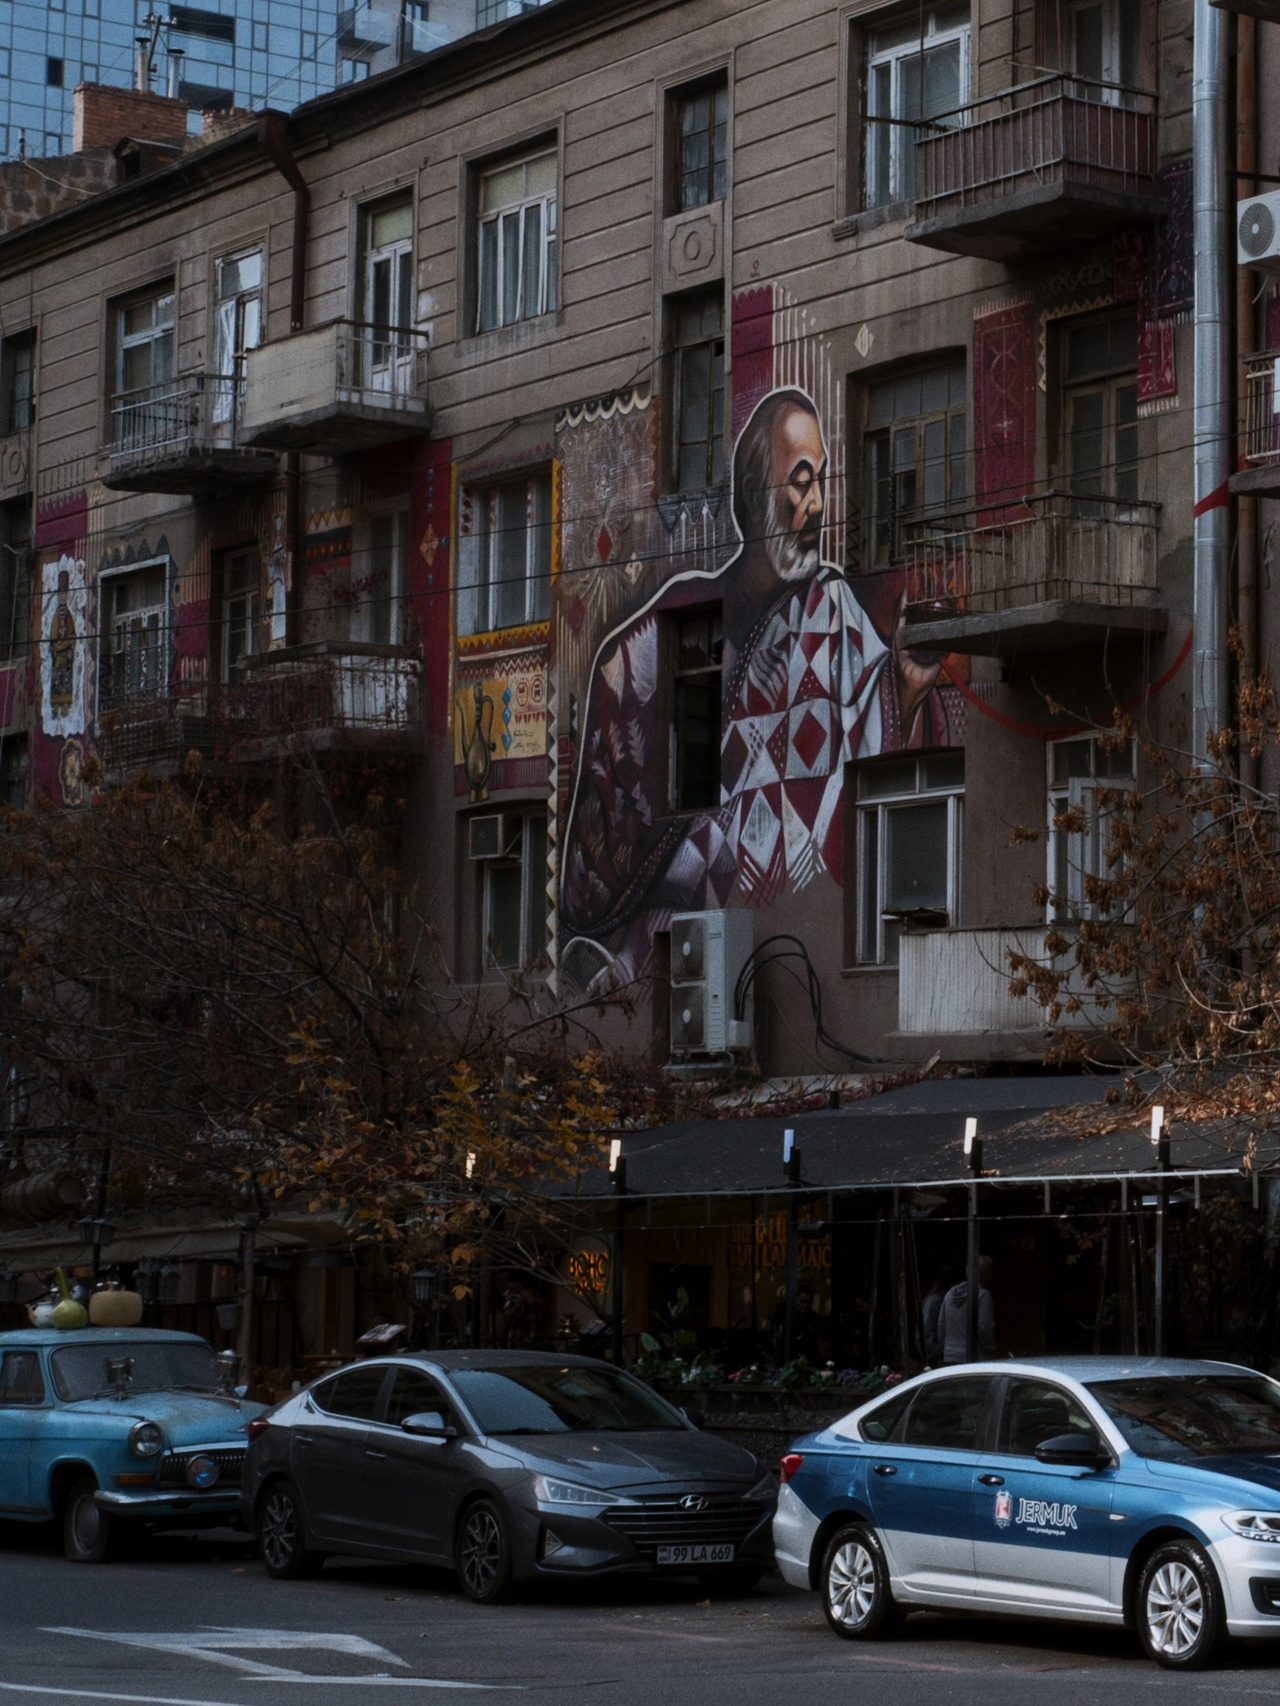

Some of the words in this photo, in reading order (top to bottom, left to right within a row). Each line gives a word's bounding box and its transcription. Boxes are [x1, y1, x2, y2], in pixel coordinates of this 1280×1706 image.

[1015, 1497, 1078, 1530] JERMUK
[673, 1547, 688, 1562] 99
[691, 1547, 707, 1561] LA
[711, 1546, 731, 1560] 669
